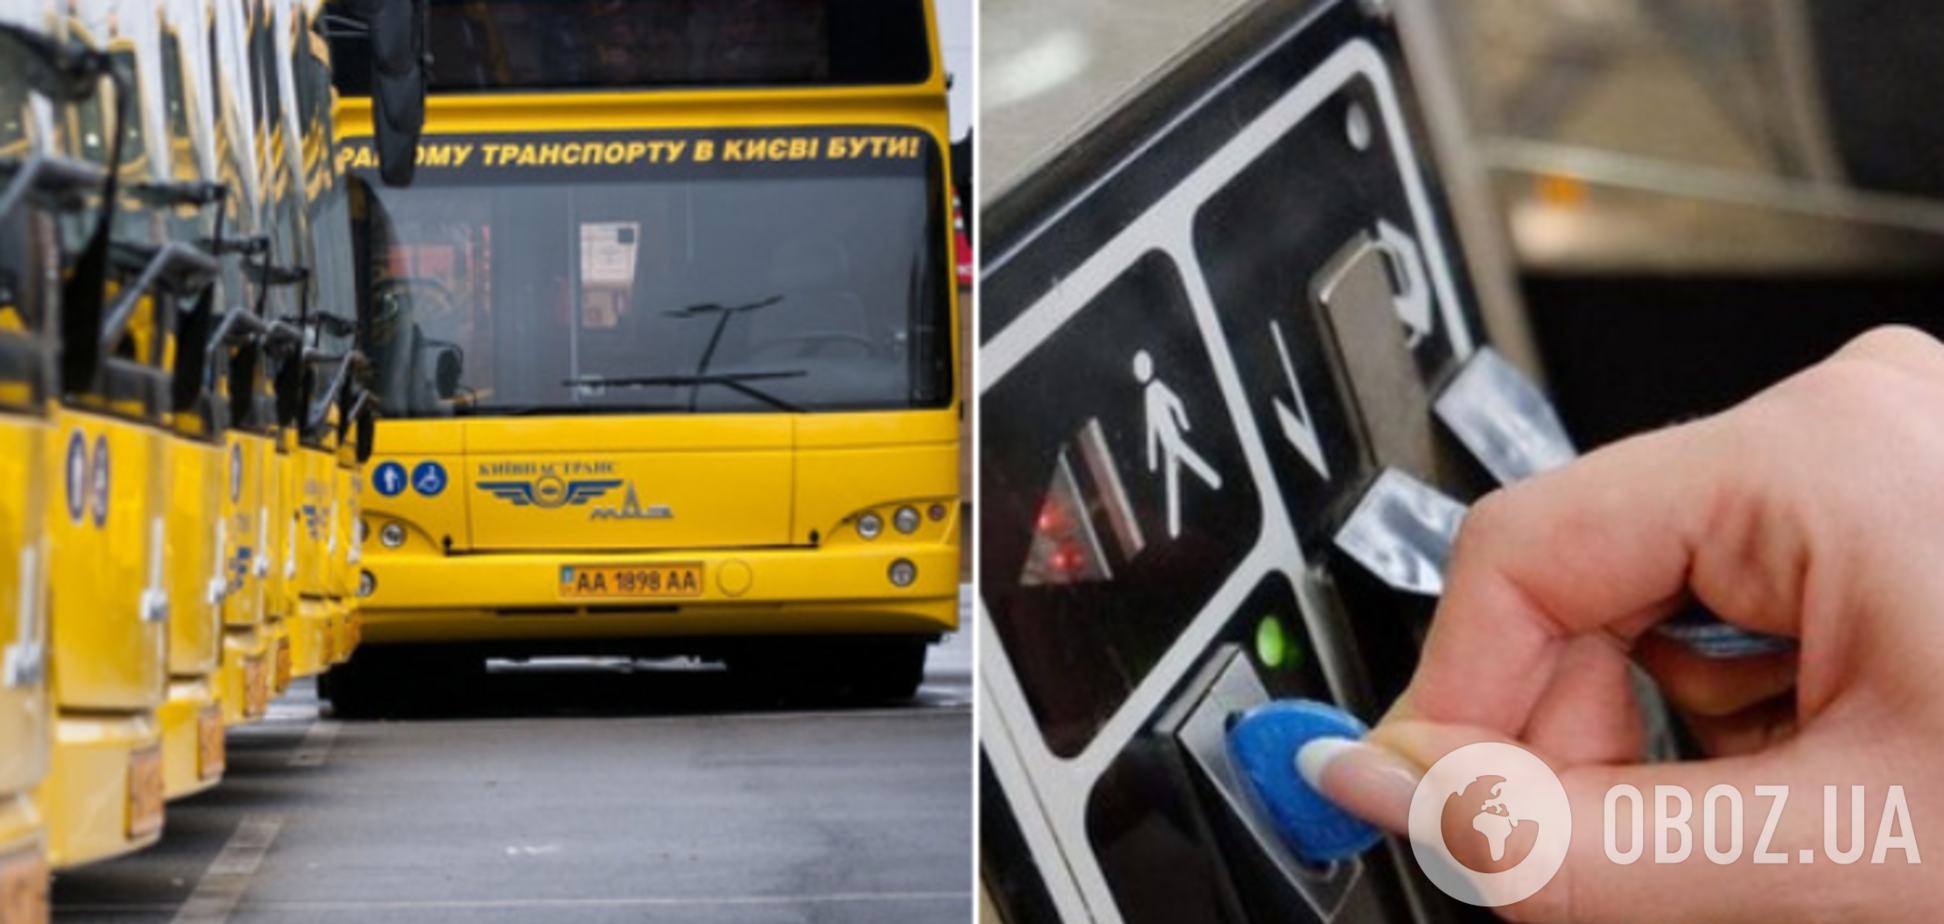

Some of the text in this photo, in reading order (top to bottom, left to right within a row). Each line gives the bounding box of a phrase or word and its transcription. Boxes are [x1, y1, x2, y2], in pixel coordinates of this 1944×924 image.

[482, 140, 686, 166] ТРАНСПОРТУ
[692, 139, 714, 161] В
[723, 137, 819, 161] КИЄВІ
[827, 136, 919, 159] БУТИ!
